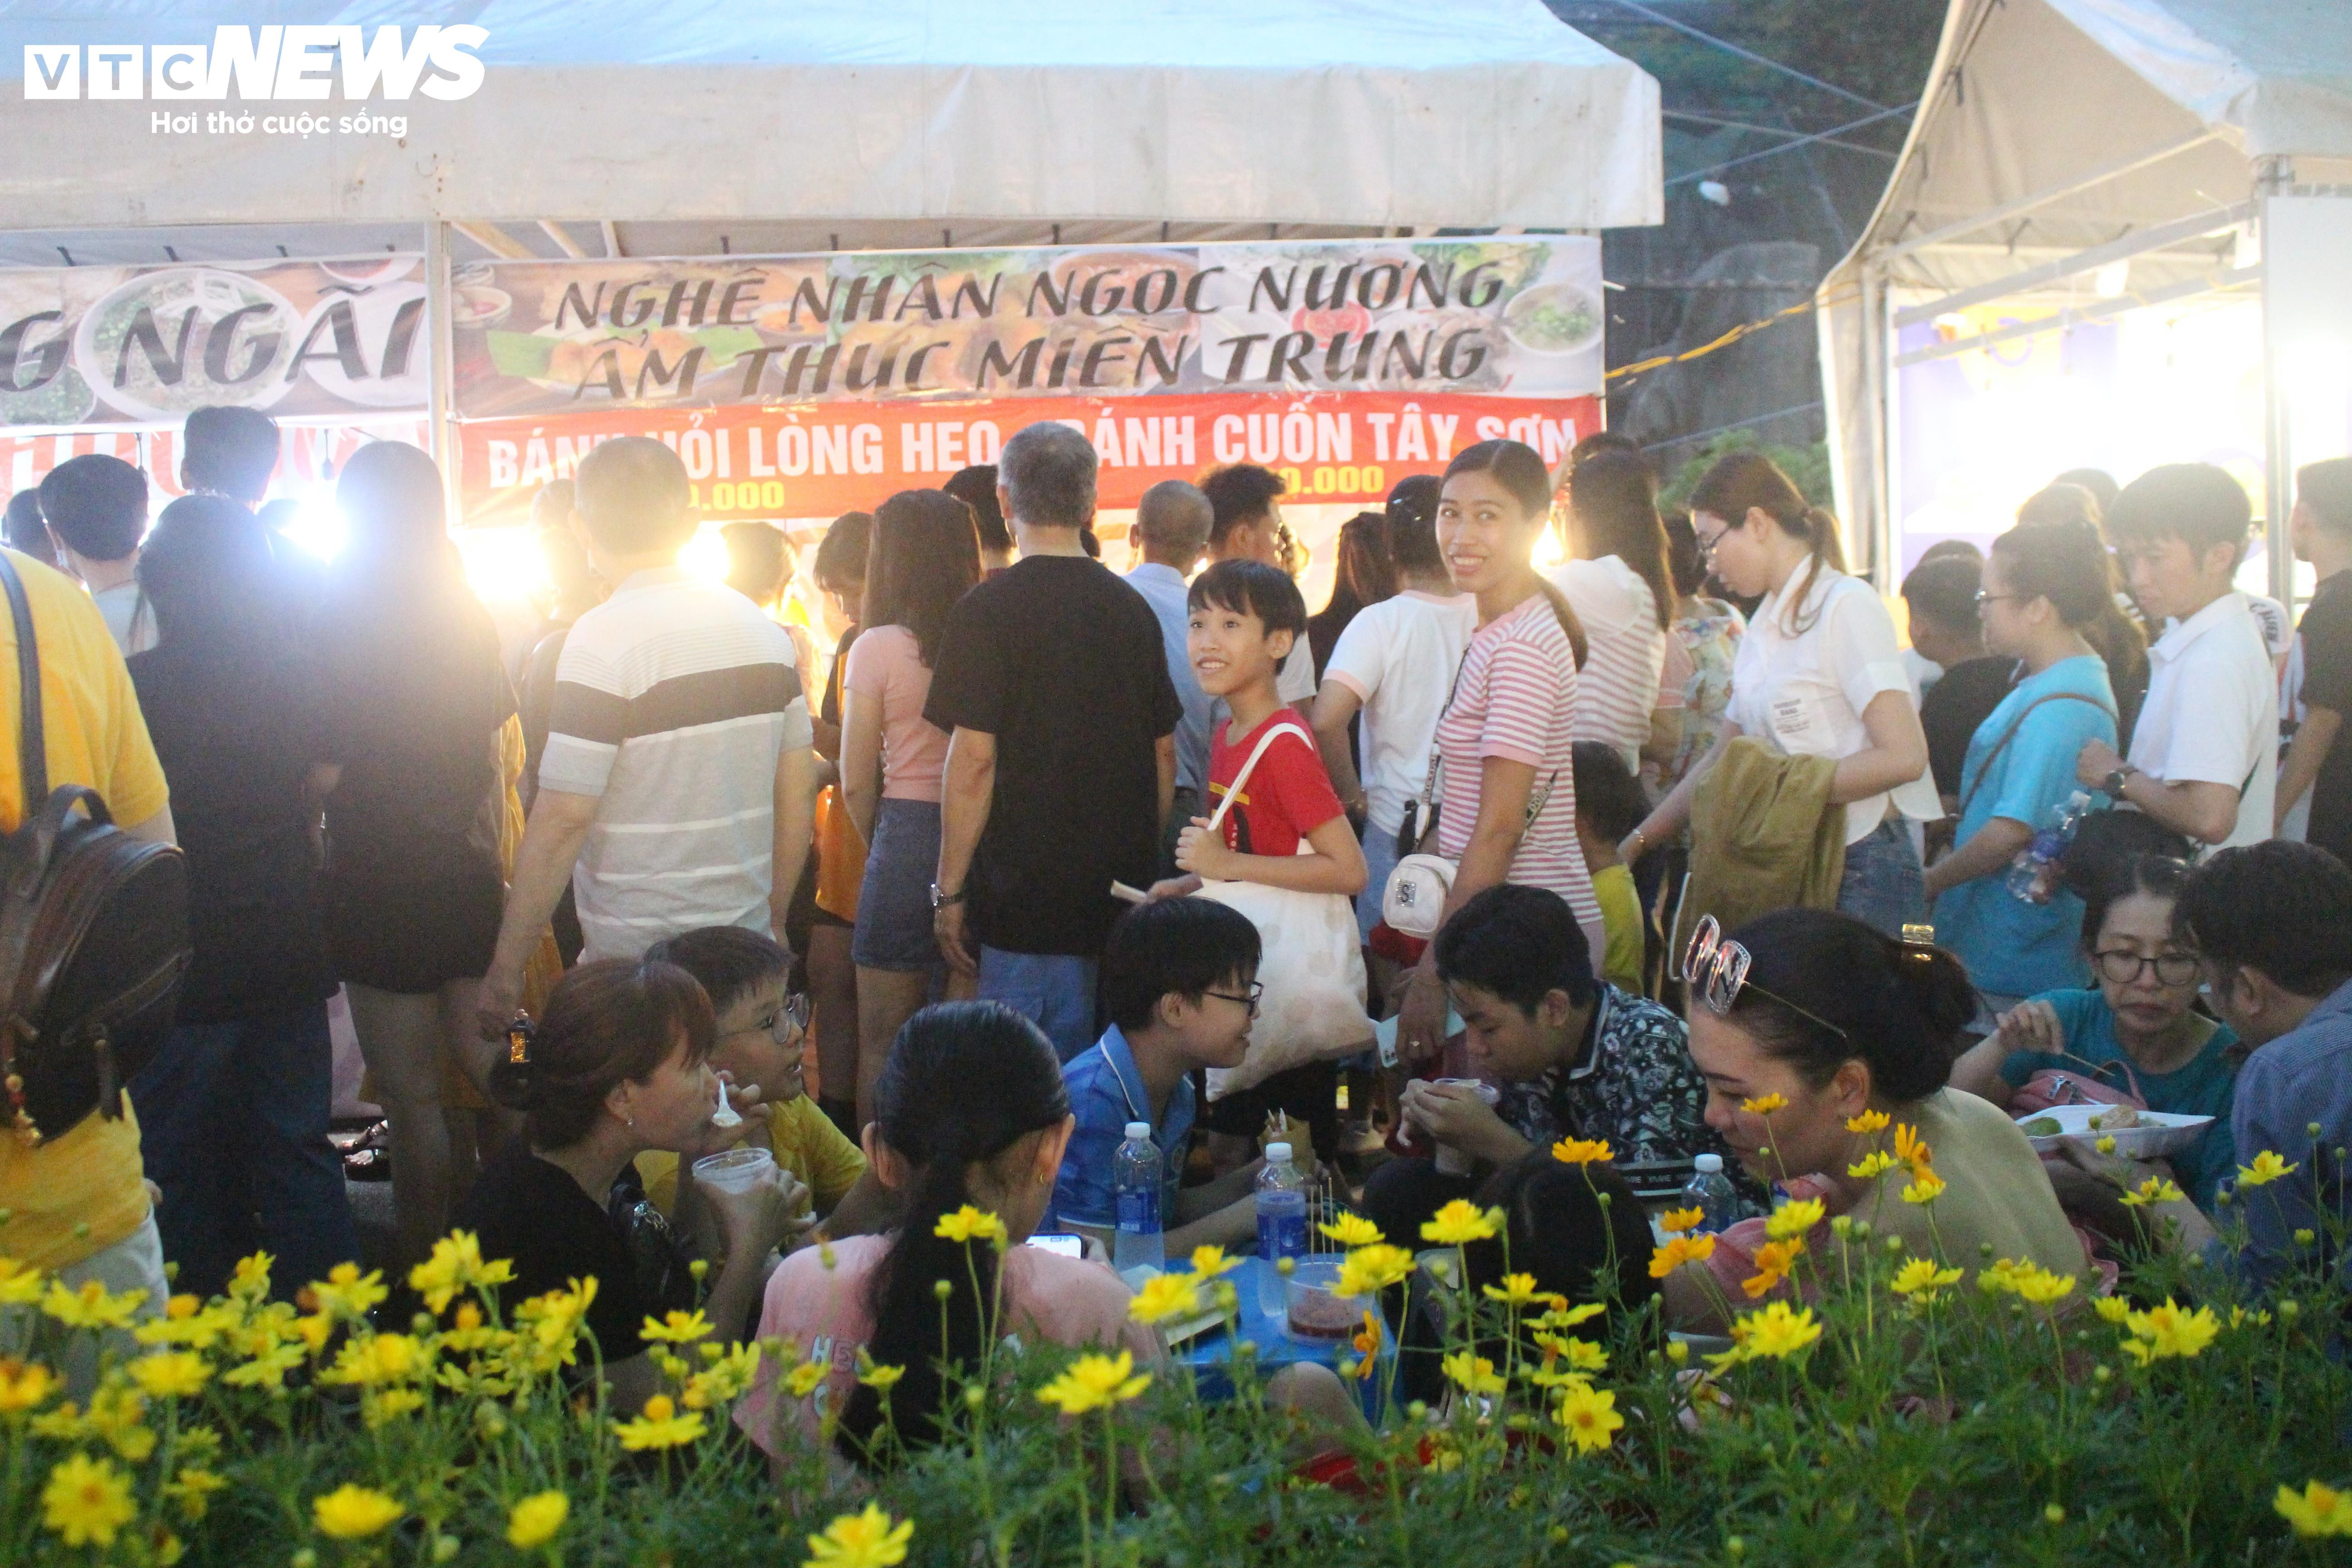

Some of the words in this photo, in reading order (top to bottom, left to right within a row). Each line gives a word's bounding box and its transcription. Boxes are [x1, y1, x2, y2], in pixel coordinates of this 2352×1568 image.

[789, 262, 1003, 323] NHÂN
[114, 285, 426, 389] NGÃI
[573, 328, 707, 401] ẨM
[977, 323, 1187, 391] MIỀN
[1218, 328, 1487, 385] TRUNG
[487, 427, 625, 488] BÁN
[749, 413, 883, 477] LÒNG
[902, 420, 1000, 473] HEO
[1055, 407, 1196, 467] ÁNH
[1213, 394, 1352, 464] CUỐN
[1367, 402, 1460, 461] TÂY
